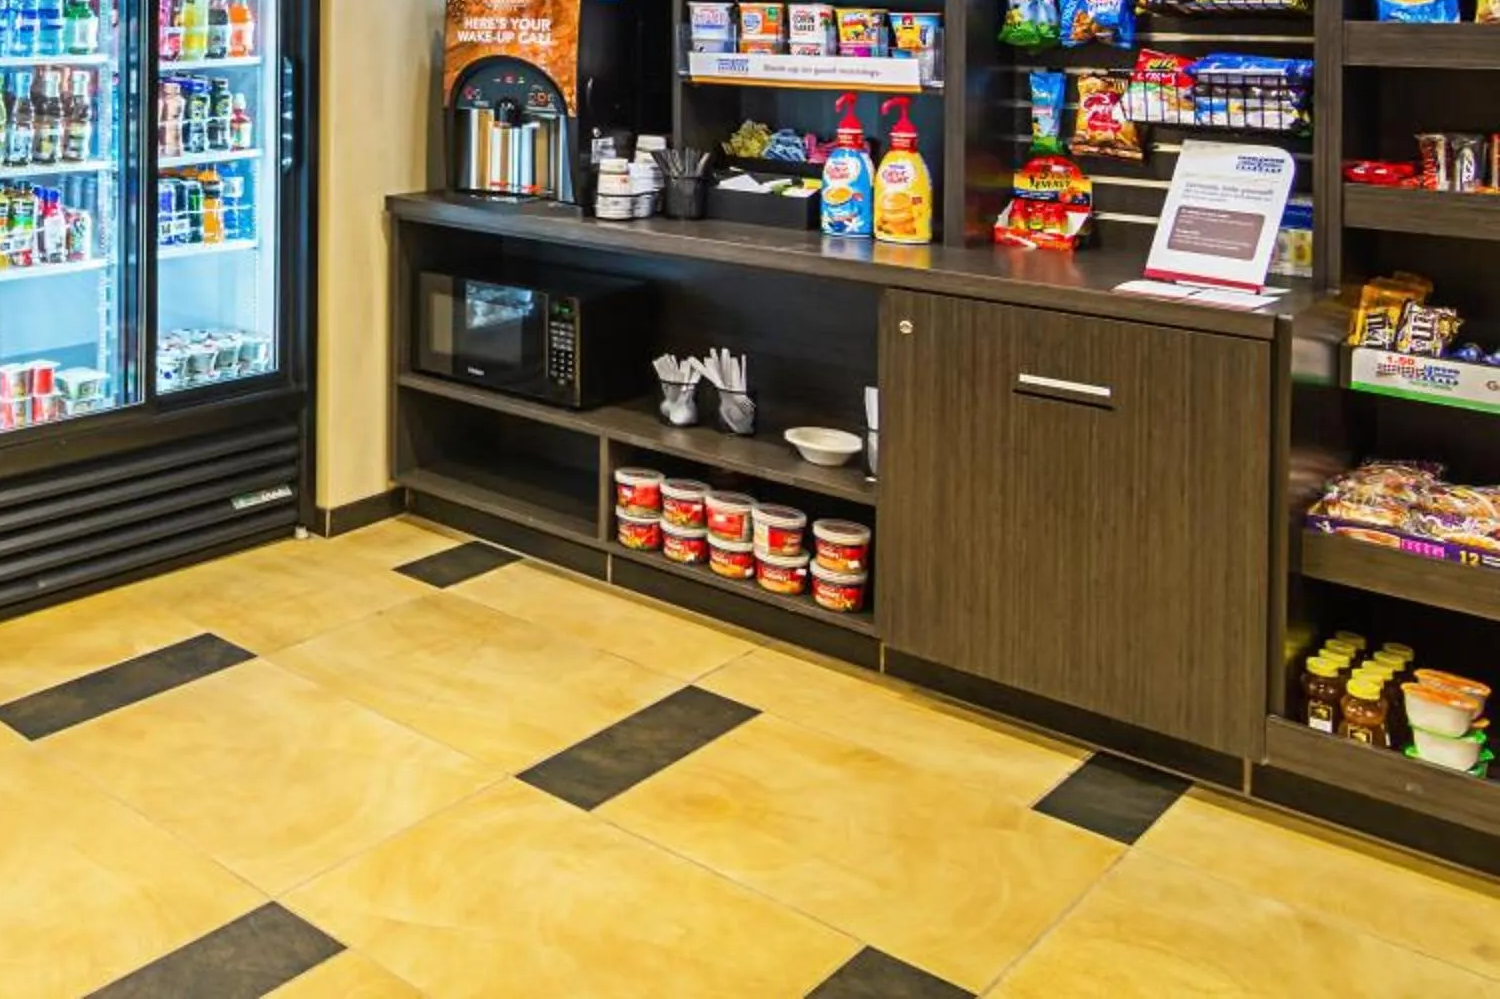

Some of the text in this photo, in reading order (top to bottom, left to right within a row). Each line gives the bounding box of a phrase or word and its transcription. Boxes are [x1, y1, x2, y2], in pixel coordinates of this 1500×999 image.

[464, 17, 551, 32] HERE'S YOUR
[457, 30, 516, 42] WAKE-UP
